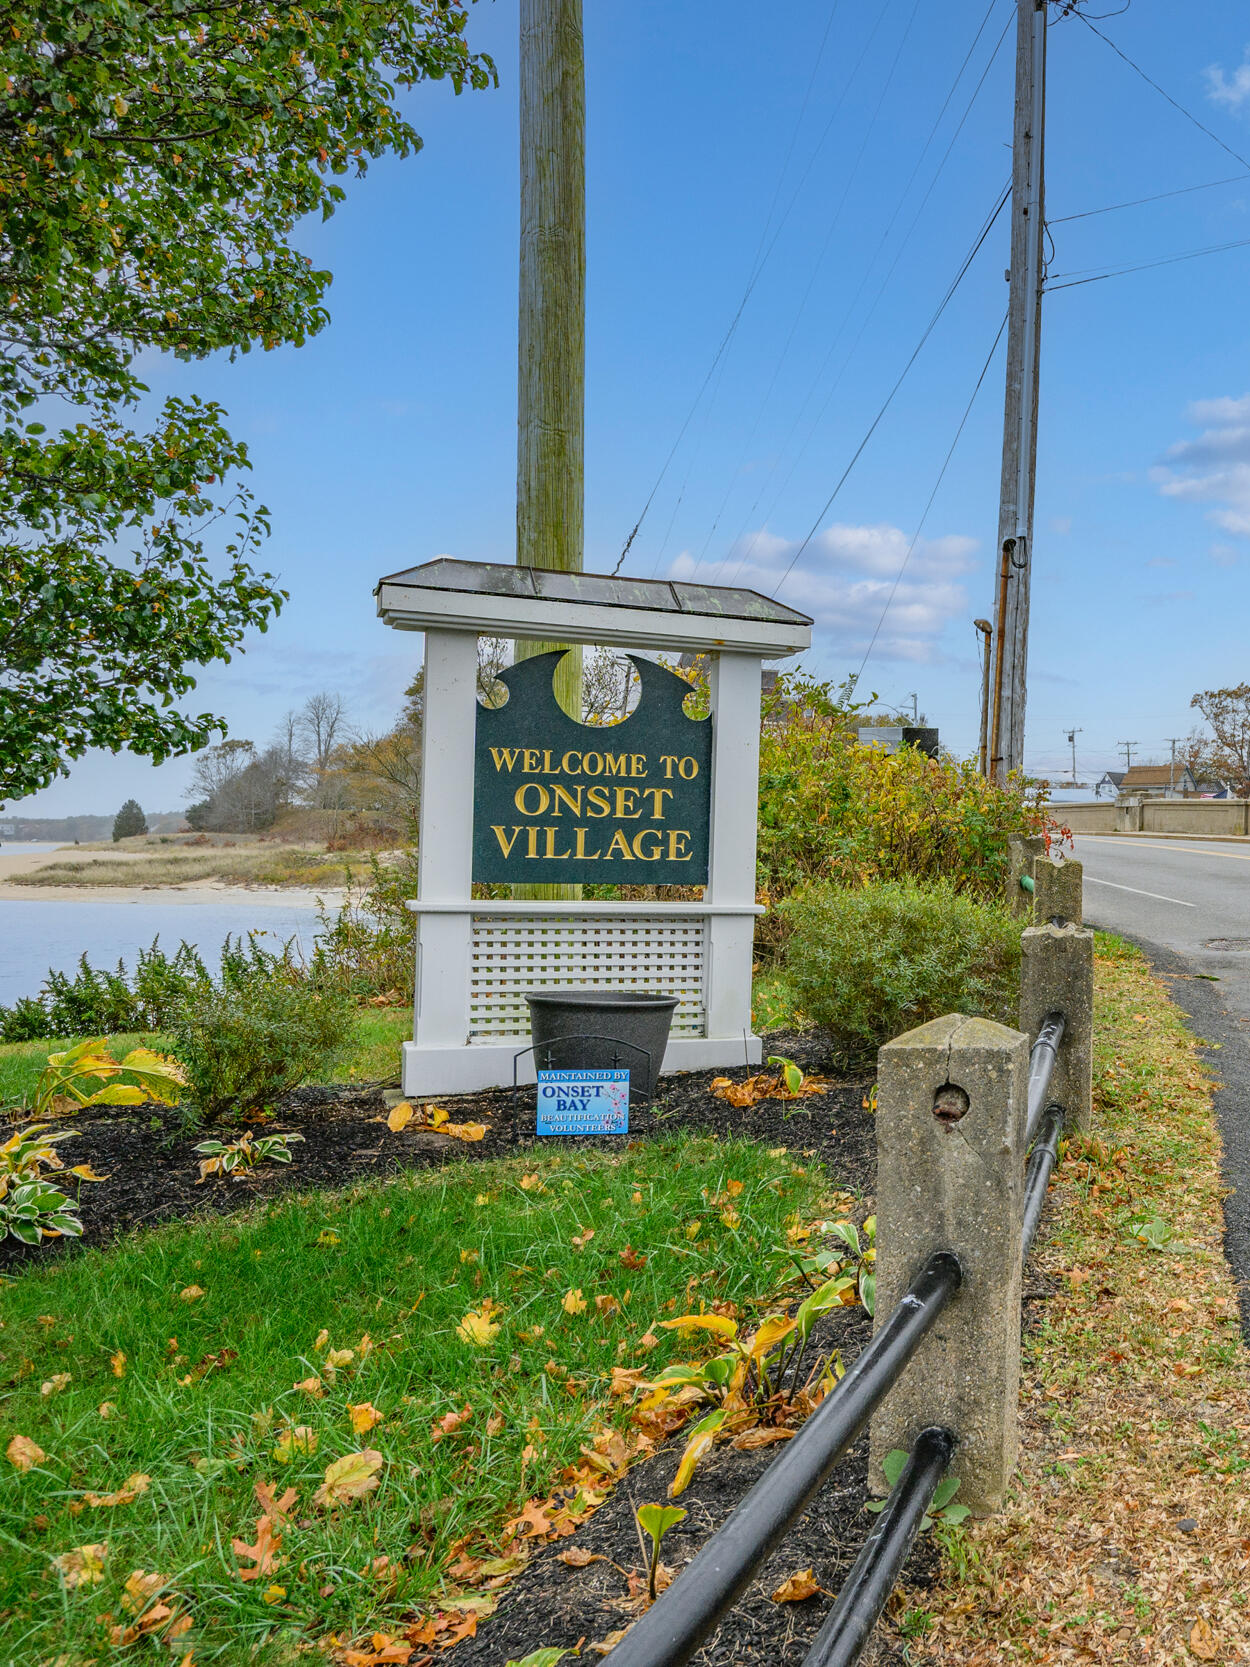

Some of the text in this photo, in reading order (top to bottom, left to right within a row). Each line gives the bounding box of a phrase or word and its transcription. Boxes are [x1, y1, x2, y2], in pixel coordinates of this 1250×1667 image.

[488, 747, 699, 780] WELCOME TO
[514, 783, 674, 820] ONSET
[490, 825, 694, 861] VILLAGE
[540, 1071, 629, 1081] MAINTAINED BY
[542, 1085, 604, 1098] ONSET
[556, 1099, 591, 1111] BAY
[540, 1113, 625, 1122] BEAUTIFICATION
[550, 1123, 616, 1132] VOLUNTEERS
